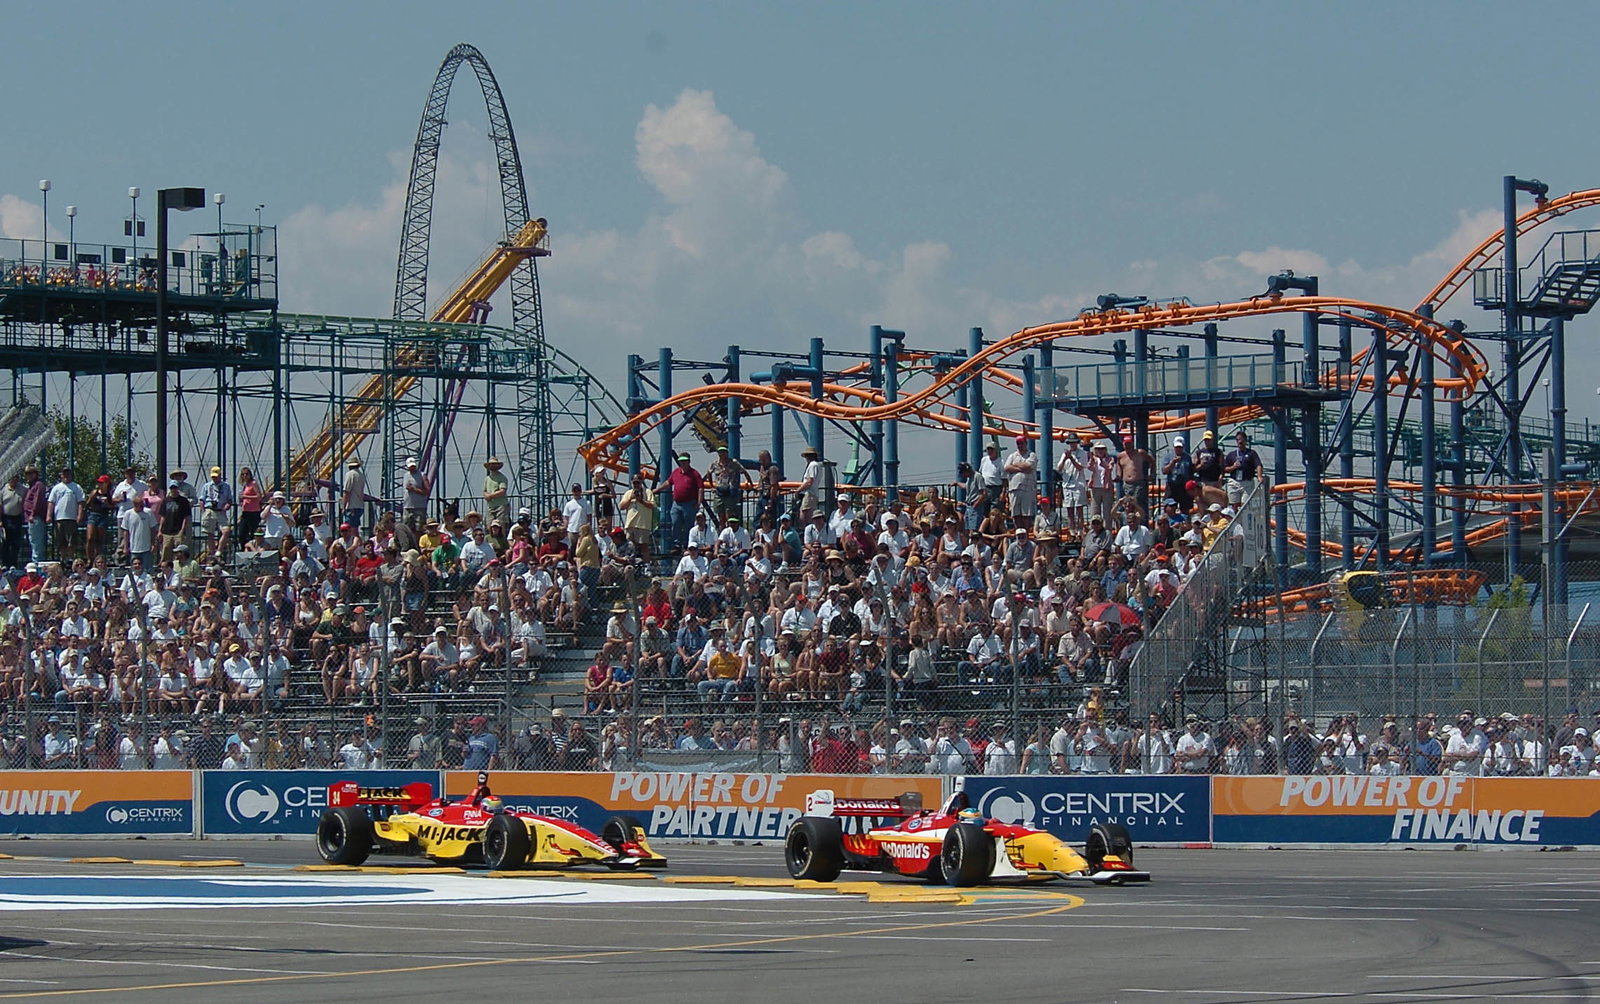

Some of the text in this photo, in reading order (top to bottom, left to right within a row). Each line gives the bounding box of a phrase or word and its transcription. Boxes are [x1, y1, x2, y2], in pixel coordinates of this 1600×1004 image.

[610, 773, 788, 803] POWER OF
[1280, 776, 1466, 806] POWER OF
[0, 790, 82, 815] UNITY
[129, 807, 183, 817] CENTRIX
[808, 796, 813, 811] 2
[1041, 793, 1185, 814] CENTRIX
[1043, 816, 1184, 826] FINANCIAL
[1392, 809, 1544, 841] FINANCE
[418, 825, 486, 845] MI-JACK
[881, 842, 930, 859] McDonald's
